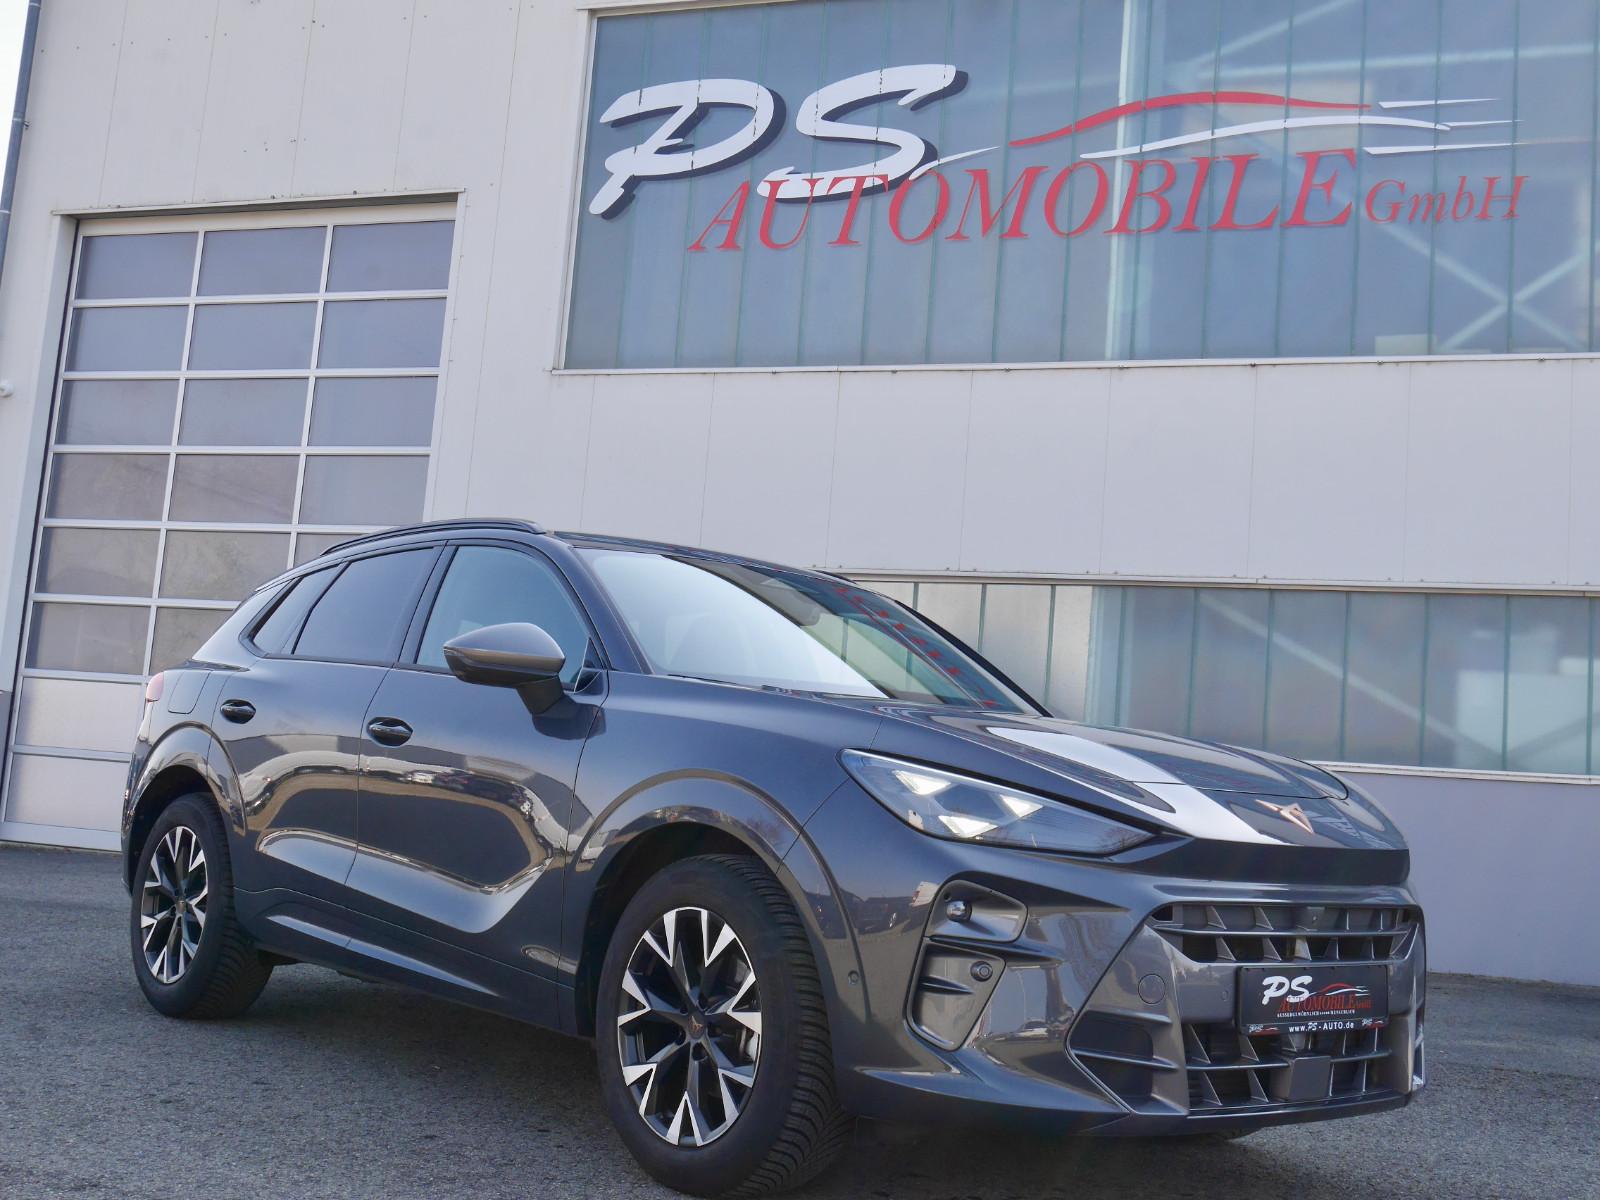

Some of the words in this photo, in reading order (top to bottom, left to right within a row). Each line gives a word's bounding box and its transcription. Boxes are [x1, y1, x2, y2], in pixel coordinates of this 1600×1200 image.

[589, 63, 970, 220] PS
[687, 147, 1357, 252] AUTOMOBILE
[1364, 174, 1531, 225] GmbH
[1261, 975, 1313, 1005] PS
